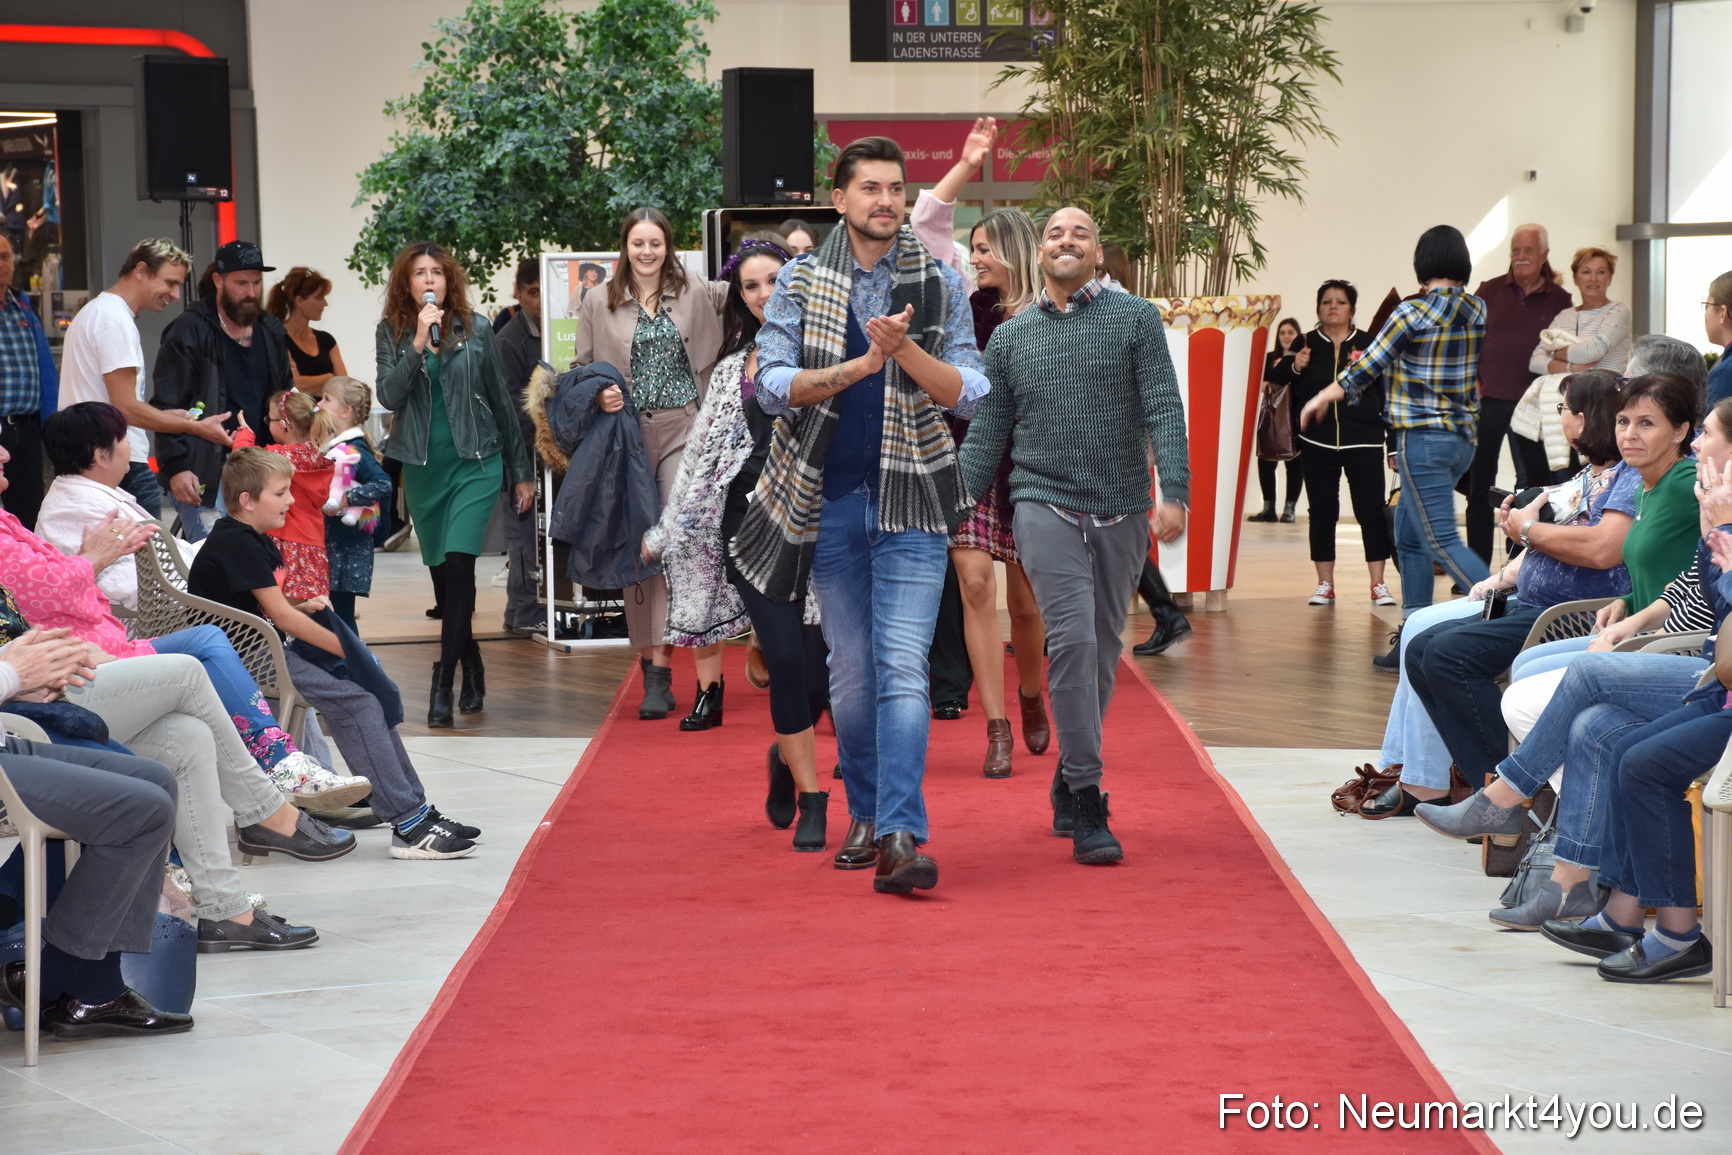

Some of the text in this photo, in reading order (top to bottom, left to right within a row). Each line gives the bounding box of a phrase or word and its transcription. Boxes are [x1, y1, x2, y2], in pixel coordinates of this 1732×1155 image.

[893, 32, 982, 43] IN DER UNTEREN
[893, 47, 982, 58] LADENSTRASSE
[902, 149, 953, 160] axis- und
[220, 189, 229, 197] 12
